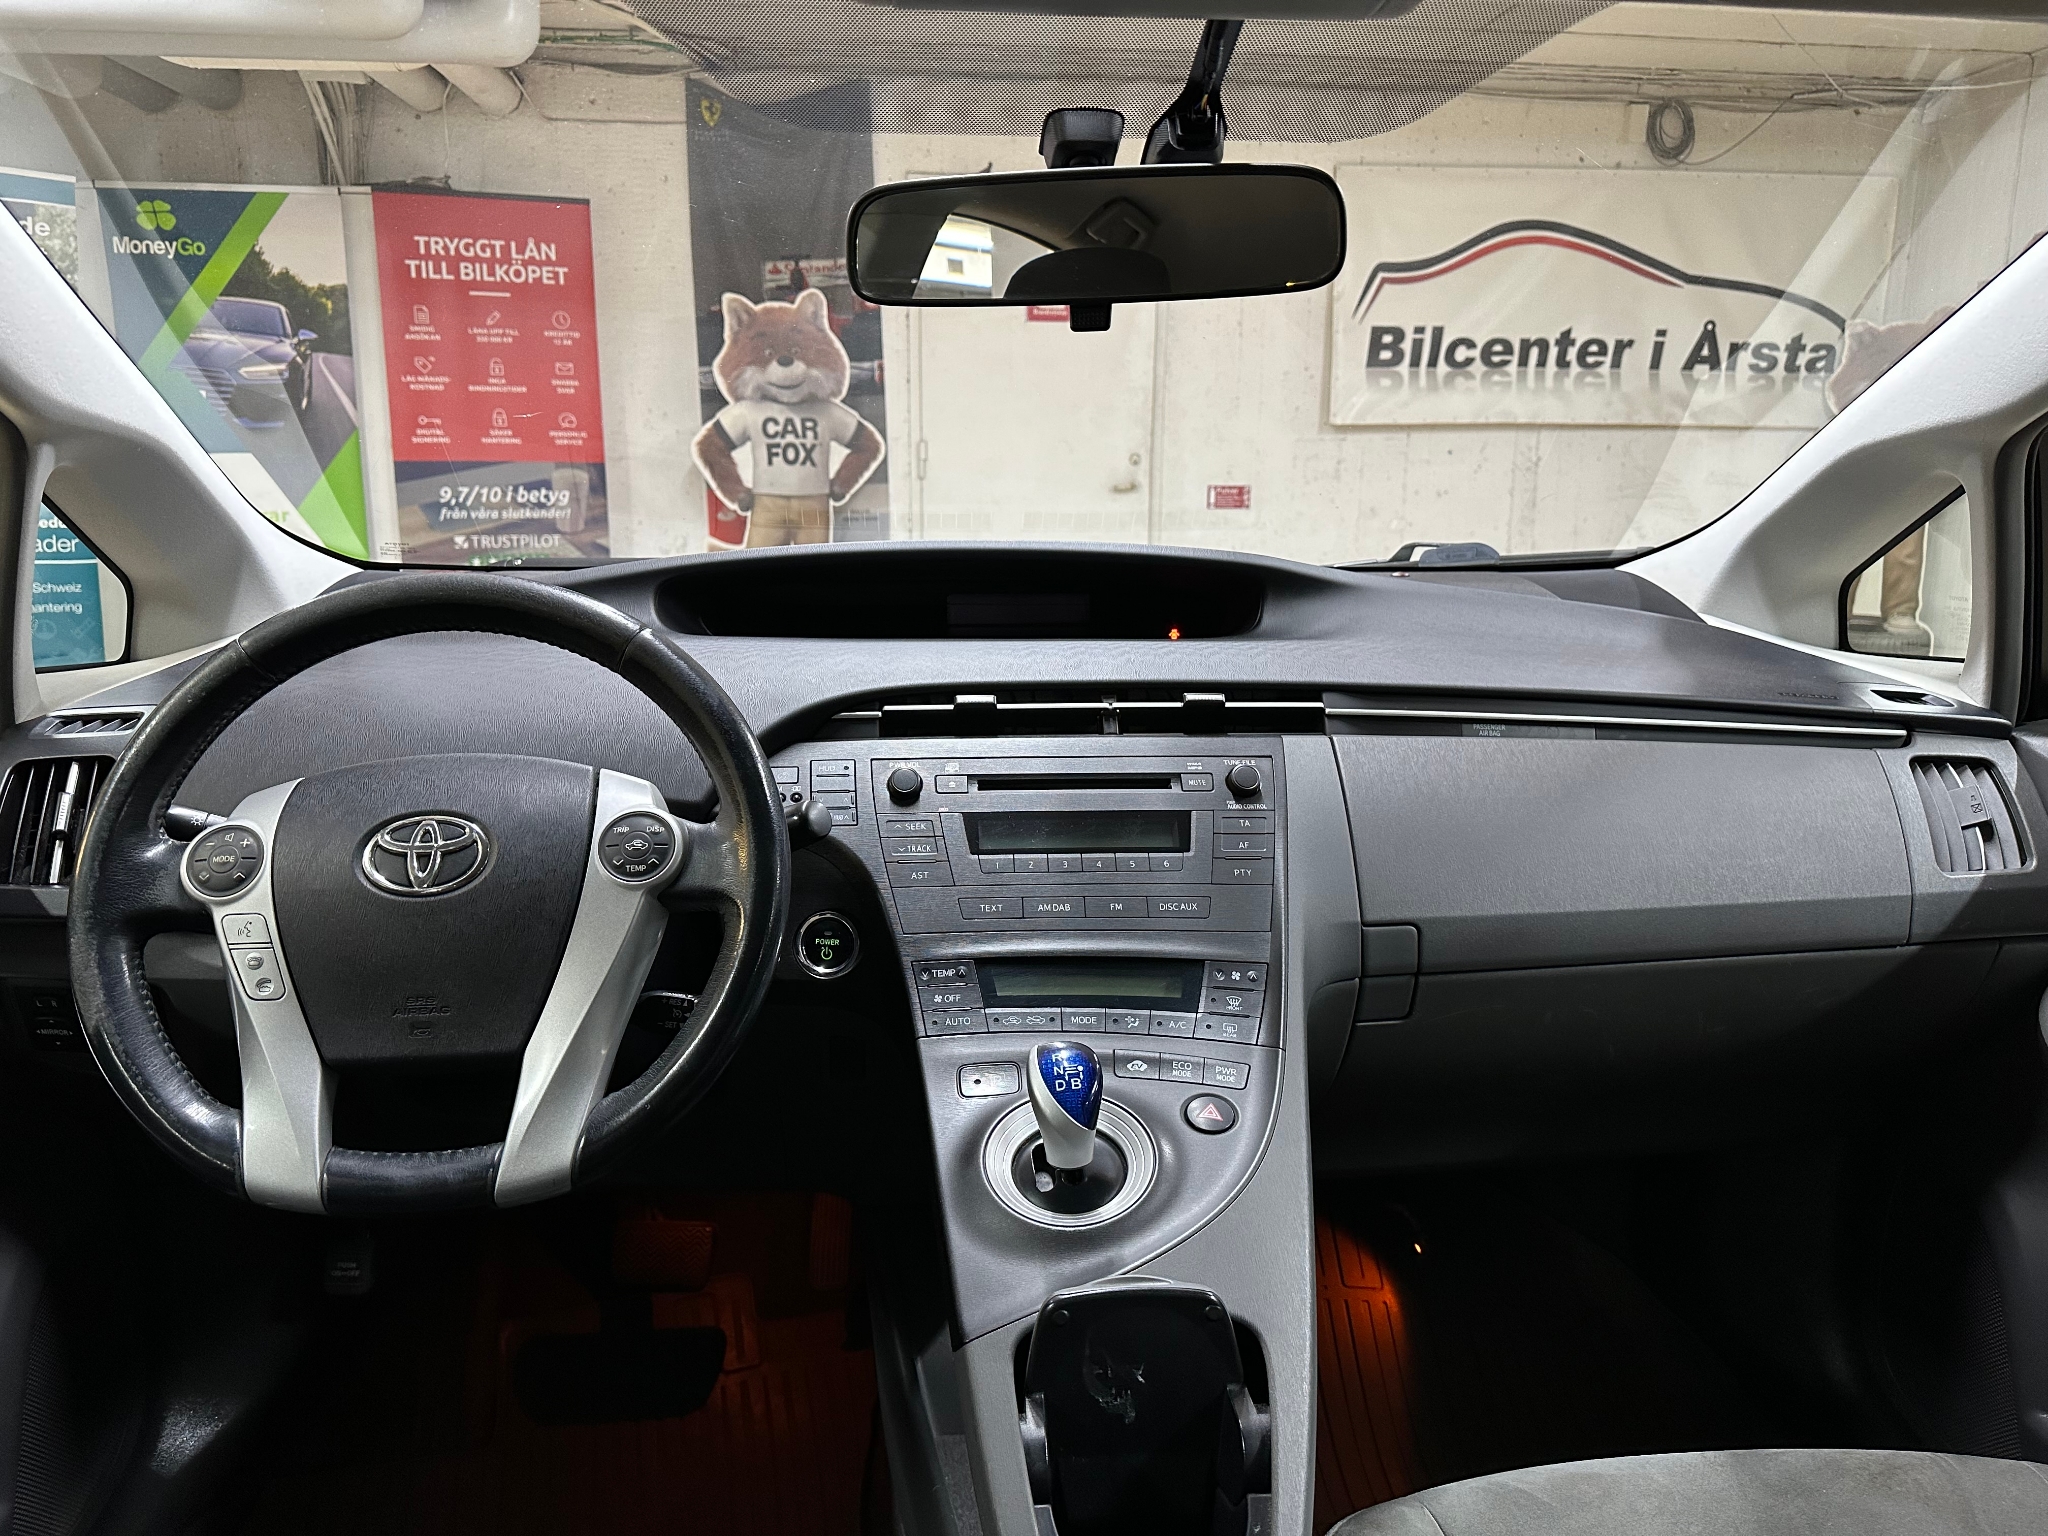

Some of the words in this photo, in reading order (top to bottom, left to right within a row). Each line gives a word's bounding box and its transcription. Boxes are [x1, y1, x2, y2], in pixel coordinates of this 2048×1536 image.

[113, 236, 206, 259] MoneyGo
[414, 236, 505, 258] TRYGGT
[511, 237, 557, 261] LÅN
[404, 259, 454, 280] TILL
[460, 260, 569, 285] BILKÖPET
[1365, 325, 1634, 371] Bilcenter
[1649, 328, 1669, 371] i
[1681, 319, 1838, 375] Årsta
[761, 416, 819, 440] CAR
[766, 442, 817, 467] FOX
[439, 485, 502, 506] 9,7/10
[505, 485, 514, 503] i
[516, 485, 570, 507] betyg
[439, 506, 468, 521] från
[469, 505, 499, 520] våra
[501, 505, 572, 520] slutkunder!
[469, 533, 561, 549] TRUSTPILOT
[32, 581, 83, 594] Schweiz
[1473, 723, 1506, 731] PASSENGER
[905, 823, 927, 831] SEEK
[1238, 819, 1251, 827] TA
[612, 826, 630, 834] TRIP
[646, 825, 665, 833] DISP
[907, 844, 932, 853] TRACK
[1238, 841, 1250, 849] AF
[212, 855, 236, 863] MODE
[625, 864, 647, 872] TEMP
[1028, 861, 1034, 869] 2
[1129, 860, 1136, 868] 5
[1163, 860, 1170, 868] 6
[910, 871, 929, 880] AST
[1233, 868, 1252, 877] PTY
[979, 903, 1003, 912] TEXT
[1109, 903, 1123, 911] FM
[1159, 903, 1179, 911] DISC
[1180, 902, 1198, 911] AUX
[815, 938, 840, 946] POWER
[932, 968, 956, 978] TEMP
[944, 994, 962, 1003] OFF
[393, 1005, 451, 1018] AIRBAG
[945, 1017, 971, 1026] AUTO
[1071, 1016, 1098, 1025] MODE
[1168, 1021, 1187, 1029] A/C
[41, 1028, 69, 1036] MIRROR
[1052, 1053, 1063, 1063] R
[1054, 1065, 1064, 1075] N
[1172, 1061, 1192, 1070] ECO
[1172, 1069, 1192, 1078] MODE
[1215, 1065, 1237, 1076] PWR
[1216, 1073, 1236, 1083] MODE
[1055, 1080, 1067, 1092] D
[1071, 1078, 1083, 1090] B
